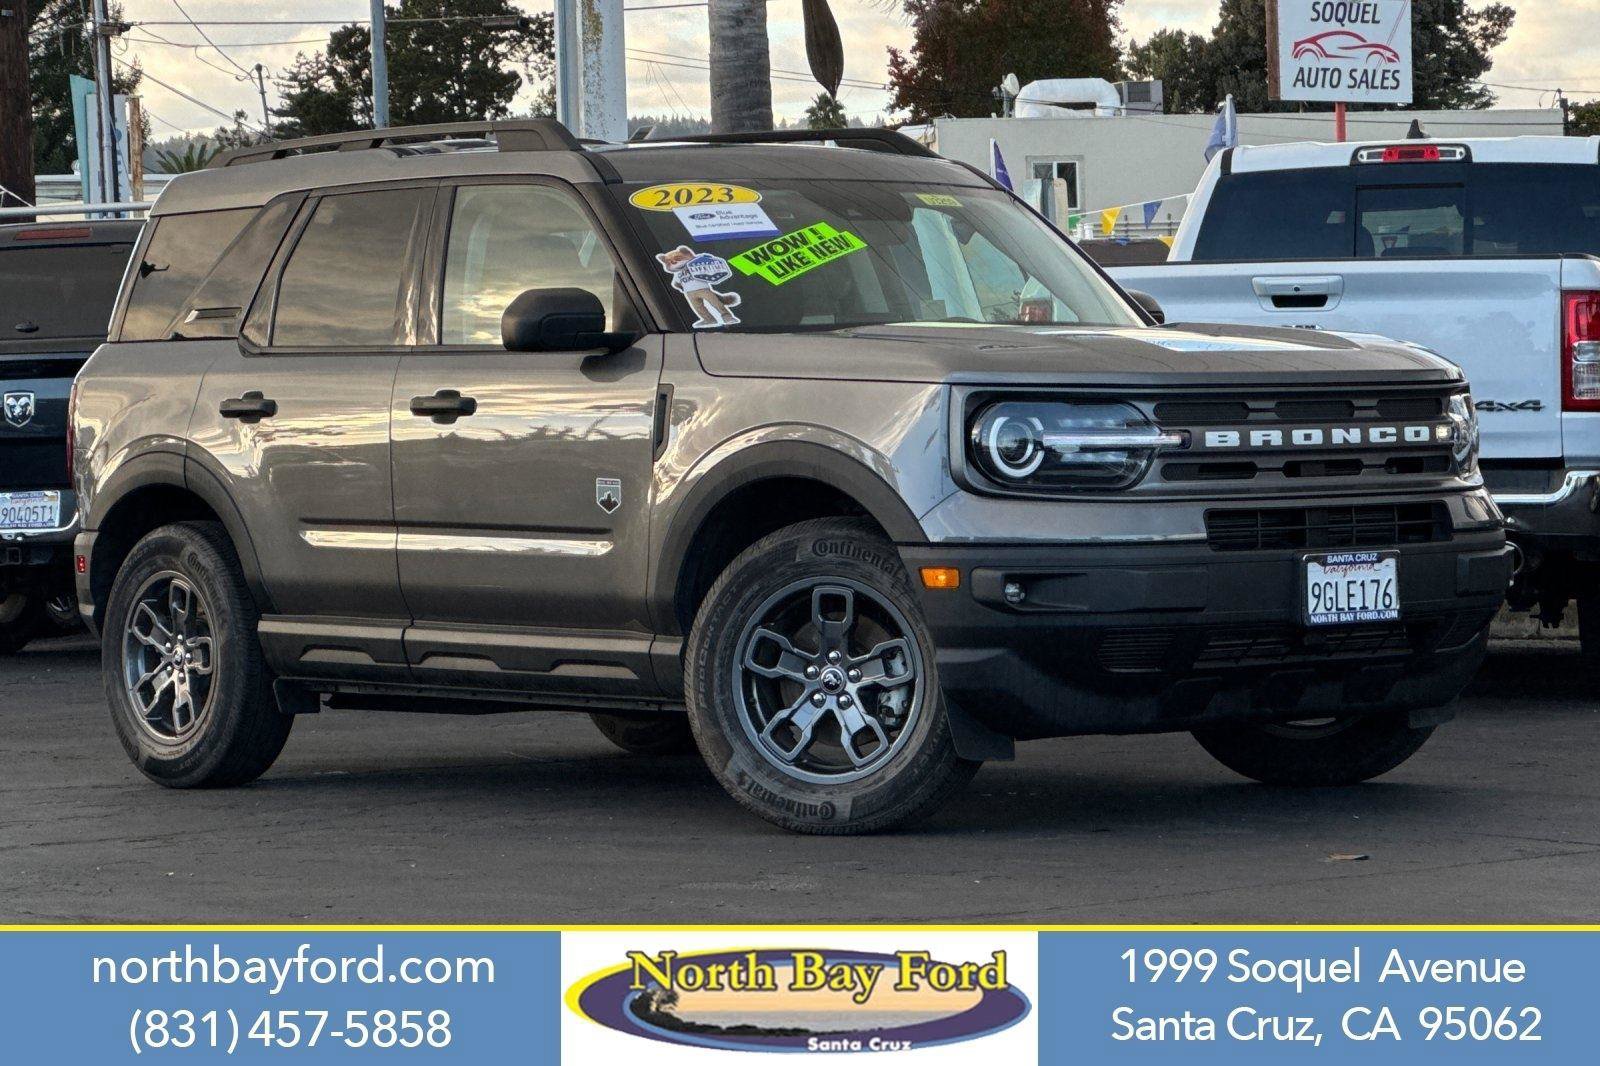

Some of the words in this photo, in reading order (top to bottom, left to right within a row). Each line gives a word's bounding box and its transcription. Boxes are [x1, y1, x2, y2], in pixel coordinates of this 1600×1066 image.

[1310, 1, 1381, 27] SOQUEL
[1292, 67, 1342, 89] AUTO
[1347, 68, 1400, 90] SALES
[653, 187, 735, 207] 2023
[766, 252, 813, 279] LIKE
[807, 233, 853, 260] NEW
[1475, 400, 1545, 411] 4x4
[1205, 426, 1431, 447] BRONCO
[1, 505, 54, 525] 90405T1
[1327, 554, 1355, 563] SANTA
[1355, 553, 1378, 562] CRUZ
[1311, 578, 1393, 613] 9GLE176
[1310, 612, 1338, 623] NORTH
[1339, 612, 1355, 622] BAY
